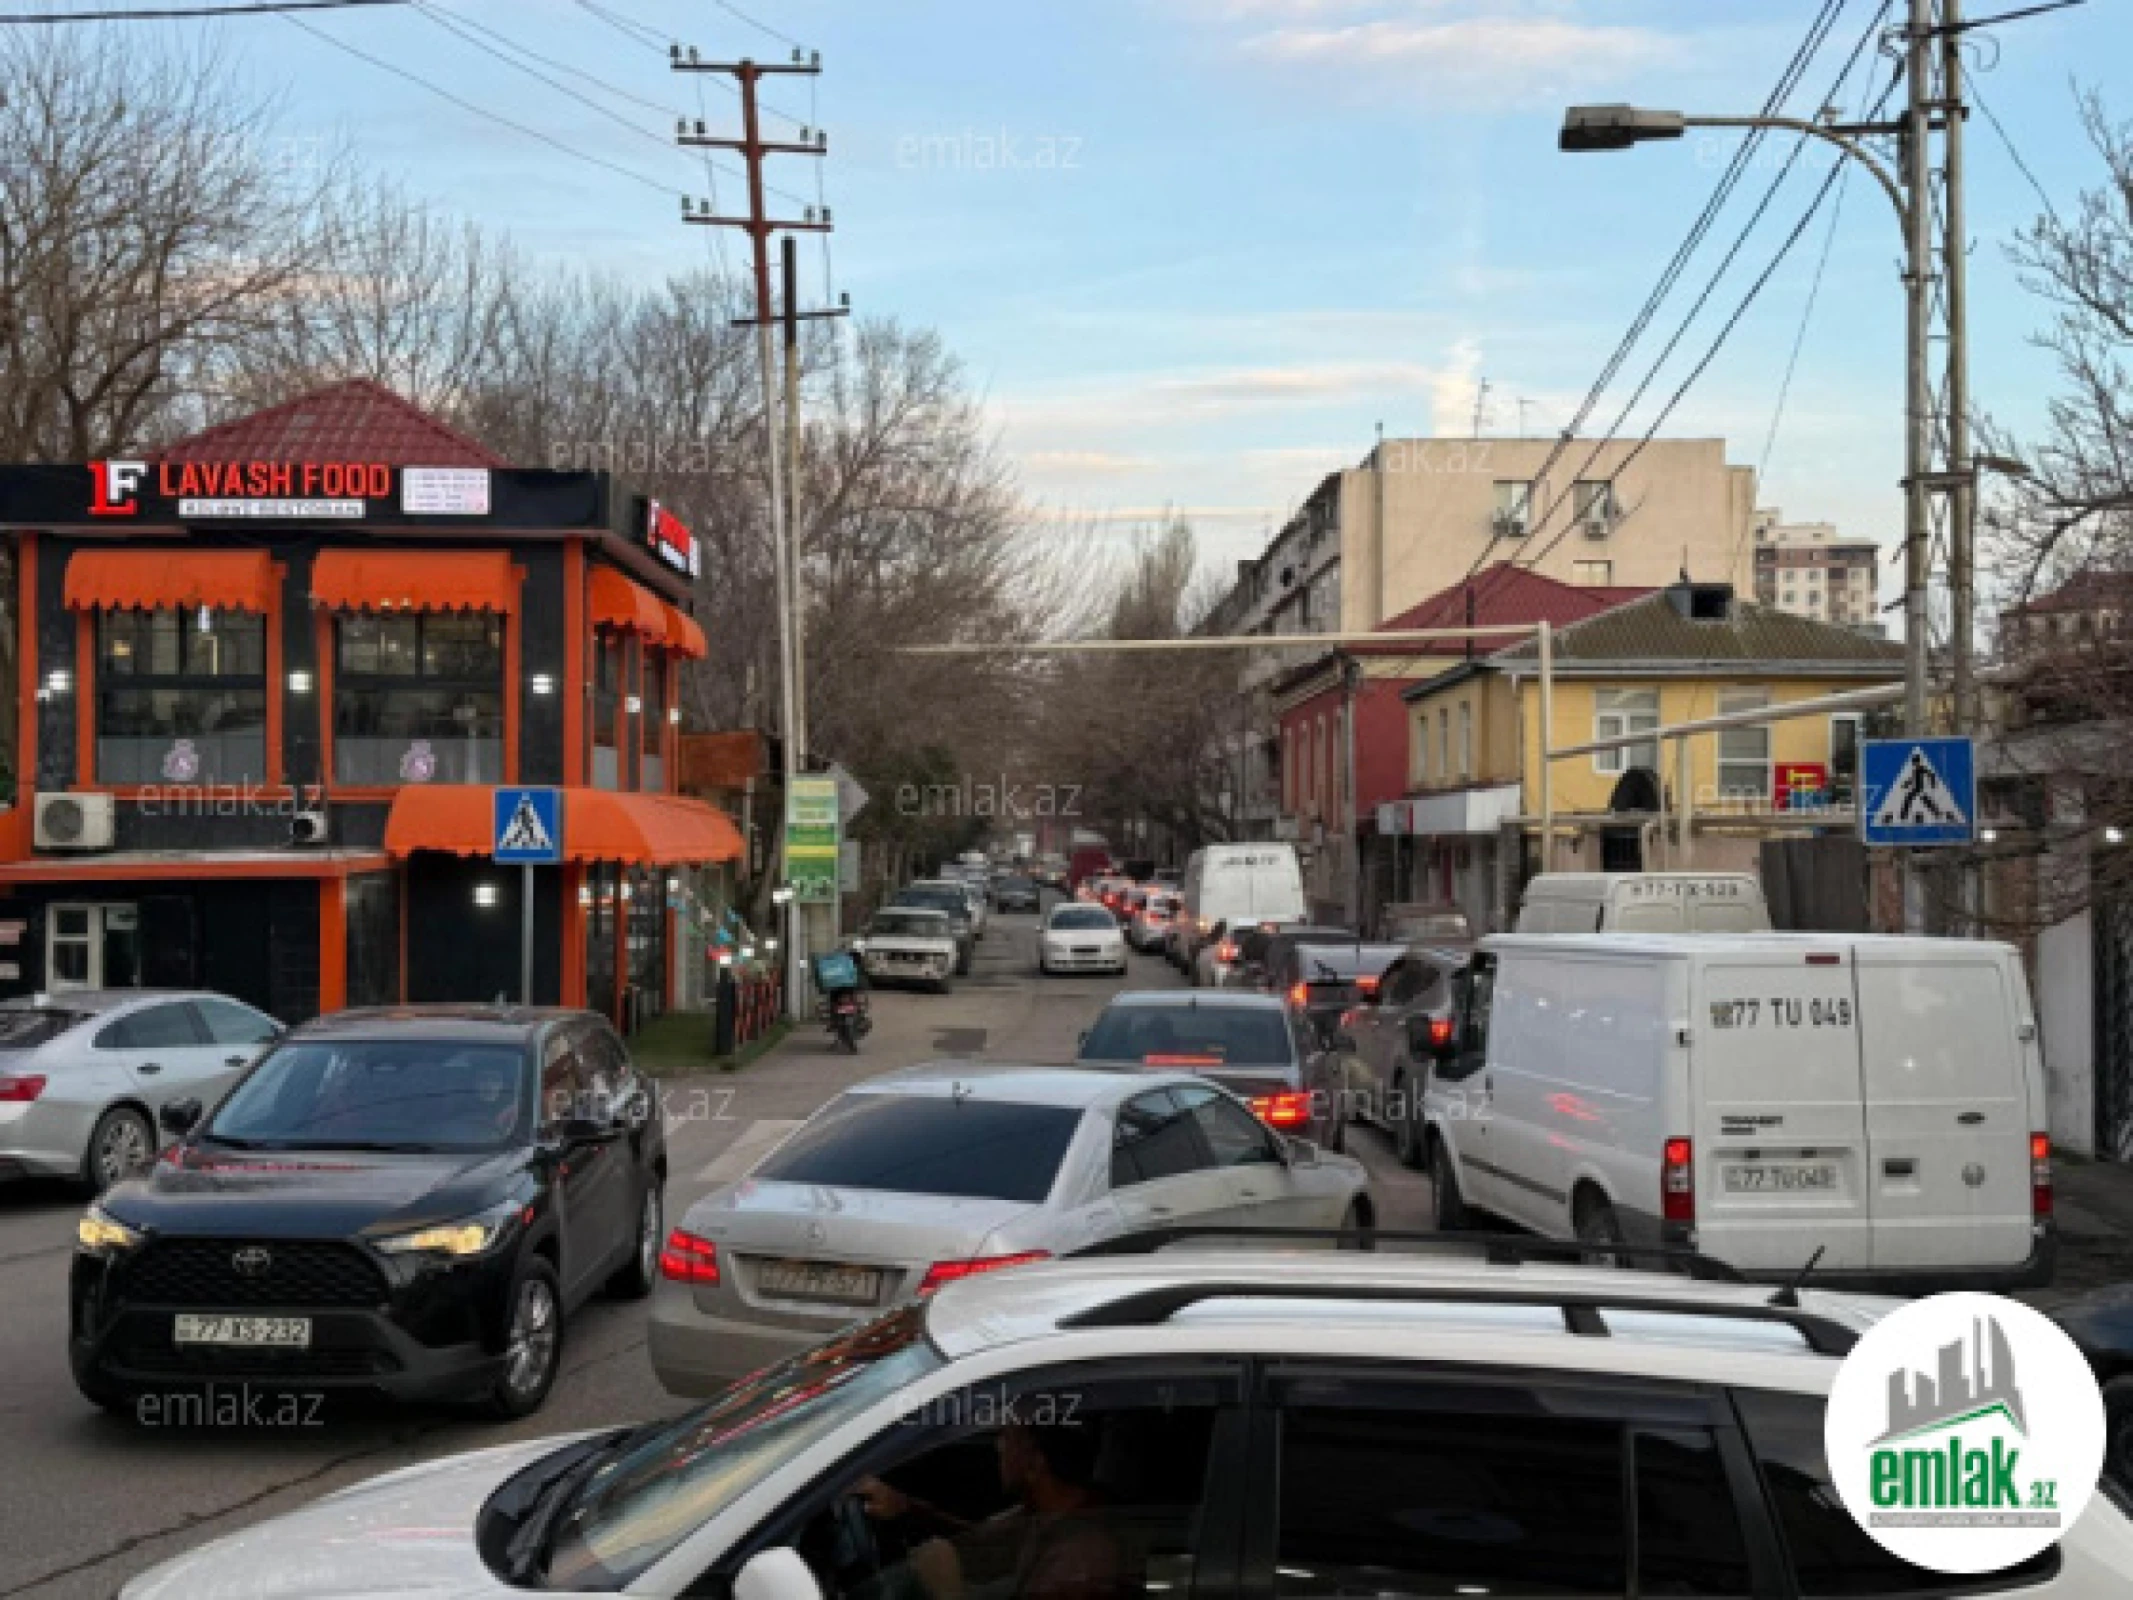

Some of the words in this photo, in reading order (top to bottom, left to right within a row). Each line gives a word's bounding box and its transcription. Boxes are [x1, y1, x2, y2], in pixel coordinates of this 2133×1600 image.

[159, 460, 291, 496] LAVASH
[303, 461, 391, 496] FOOD
[1732, 997, 1761, 1026] 77
[1769, 997, 1802, 1029] TU
